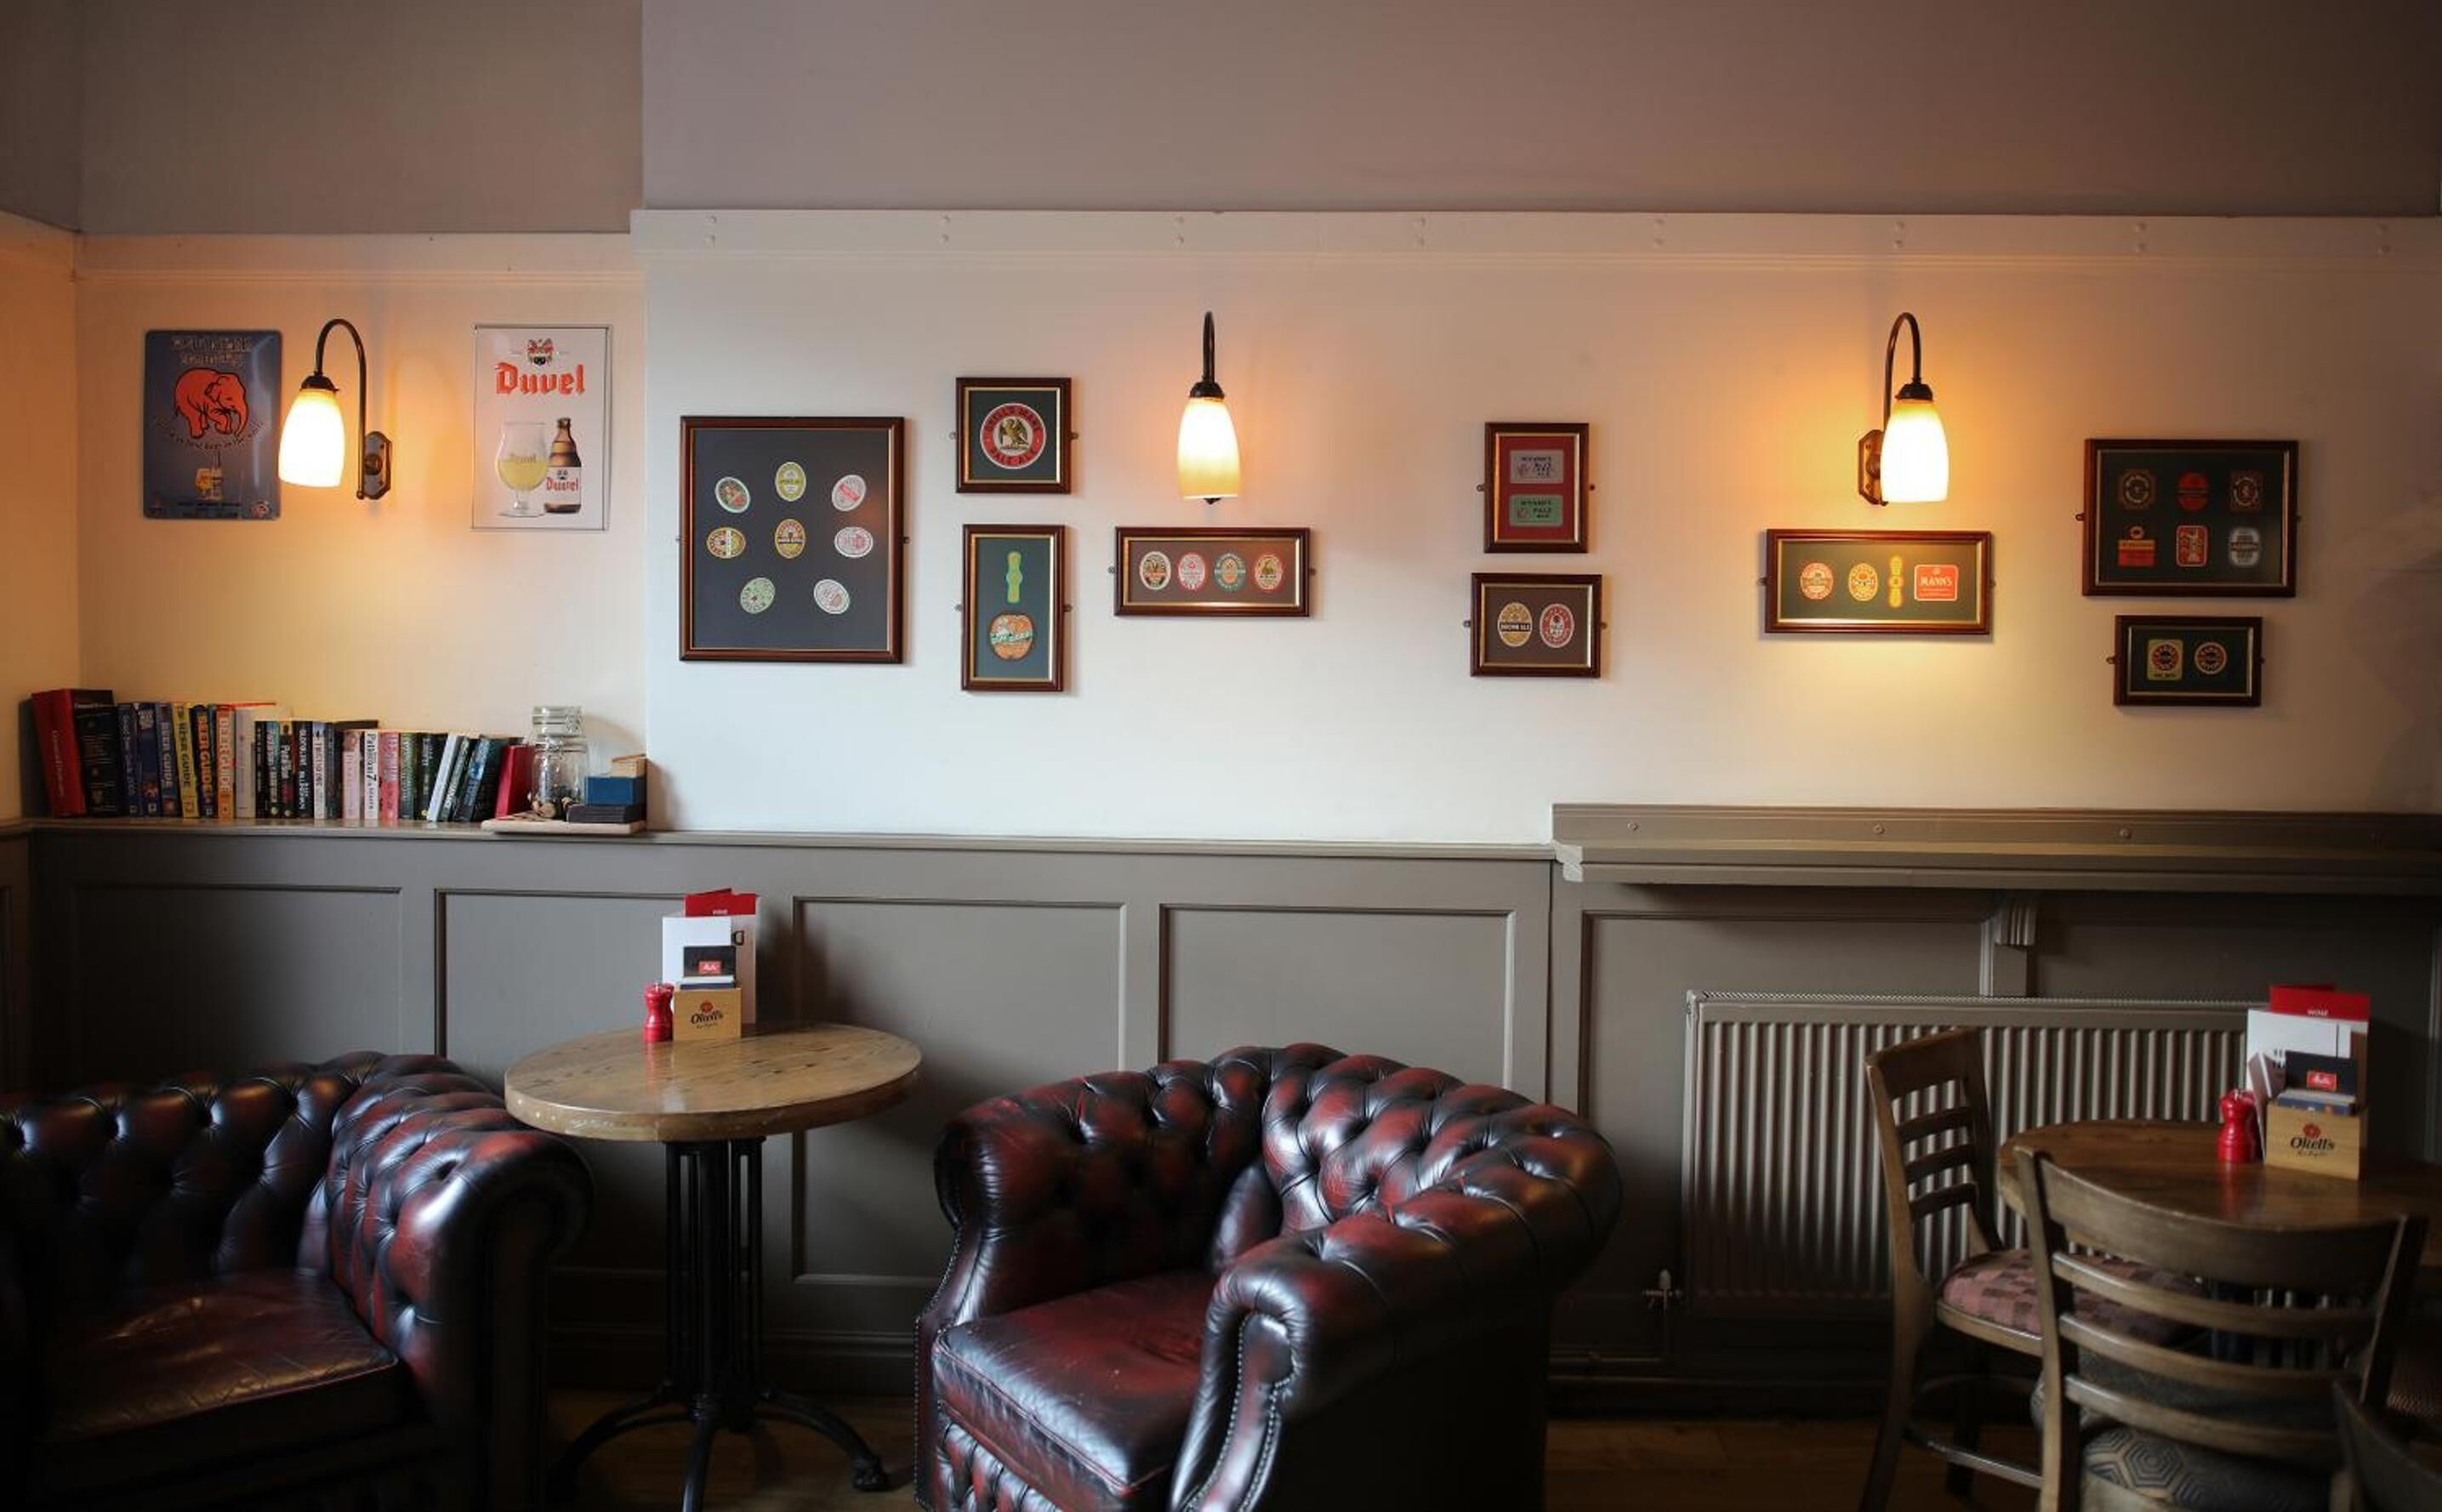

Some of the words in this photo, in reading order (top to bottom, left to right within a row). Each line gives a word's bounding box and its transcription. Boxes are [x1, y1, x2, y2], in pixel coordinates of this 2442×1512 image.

[494, 362, 586, 395] Duvel
[219, 717, 232, 753] BEER
[220, 754, 232, 793] GUIDE
